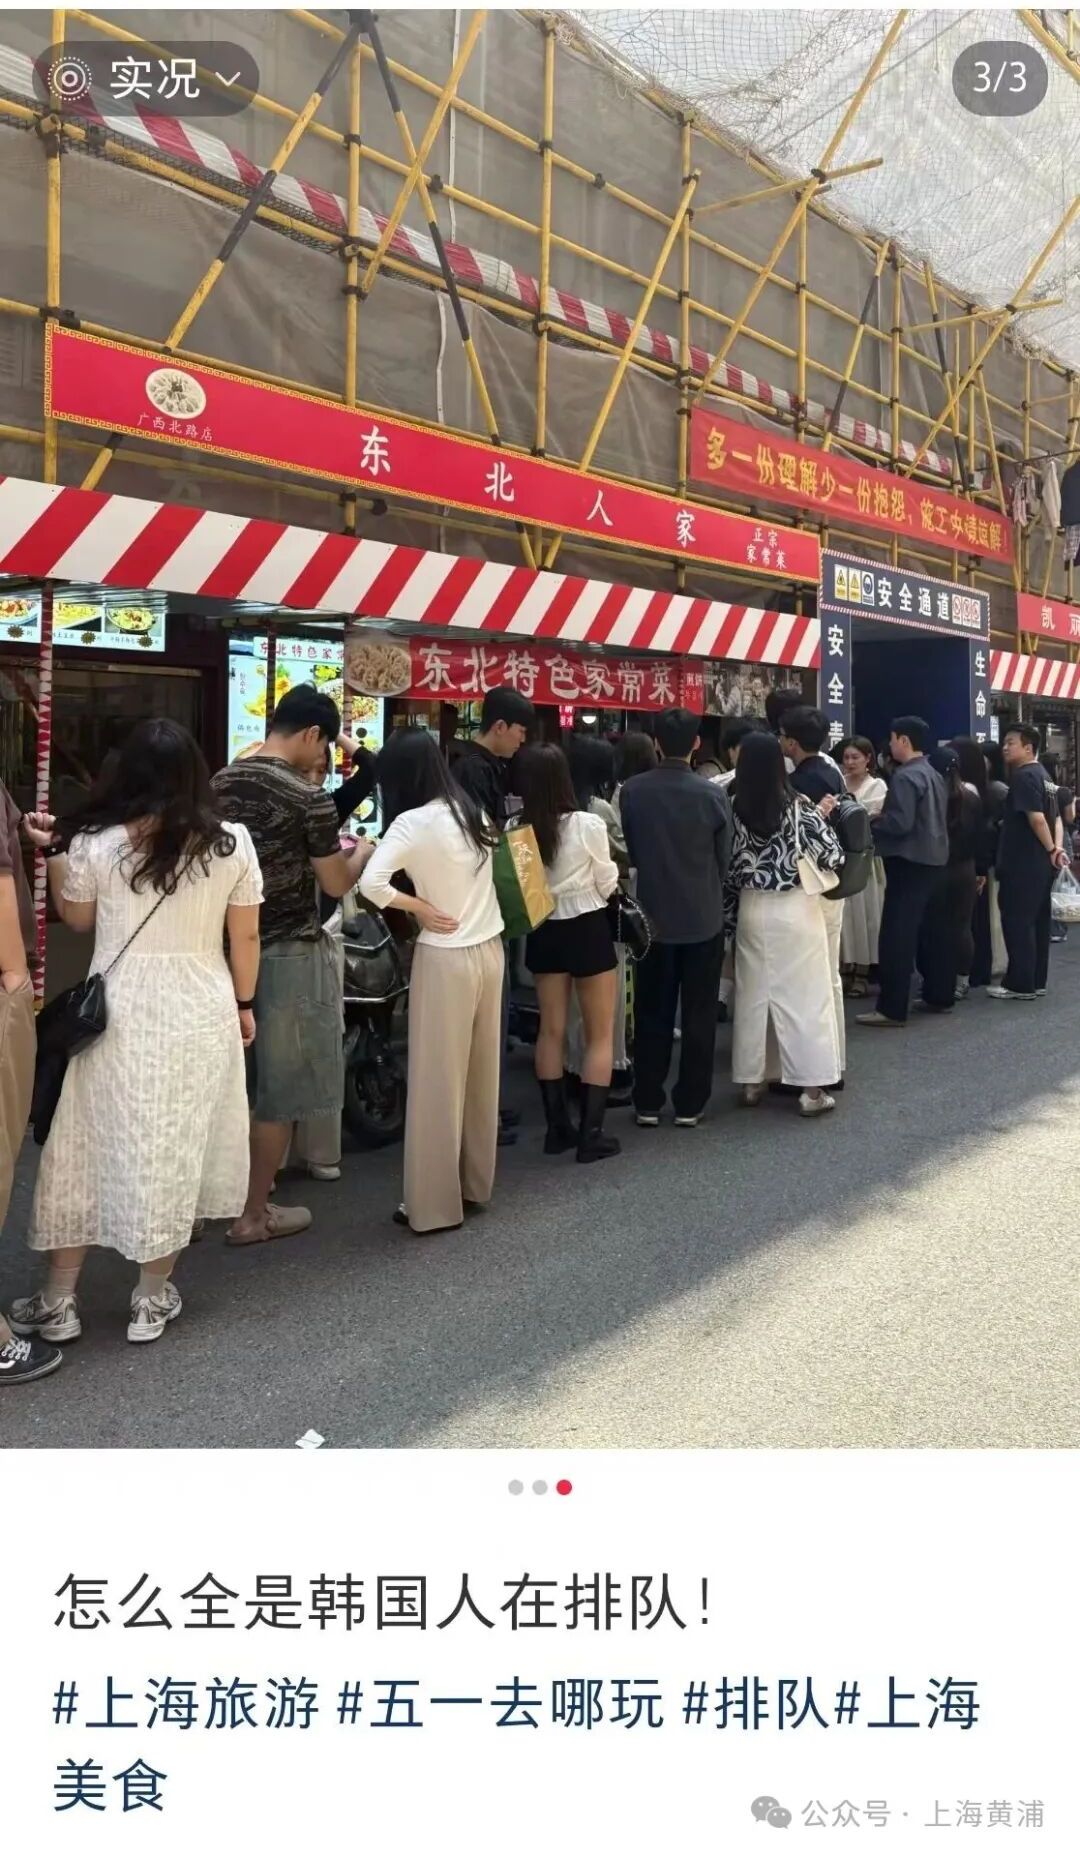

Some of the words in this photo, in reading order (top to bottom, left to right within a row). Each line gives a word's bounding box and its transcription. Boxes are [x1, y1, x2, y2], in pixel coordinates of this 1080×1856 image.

[136, 412, 214, 442] 广西北路店
[753, 527, 779, 548] 正宗
[746, 544, 787, 570] 家常菜
[877, 577, 950, 621] 安全通道
[414, 643, 676, 705] 东北特色家常菜
